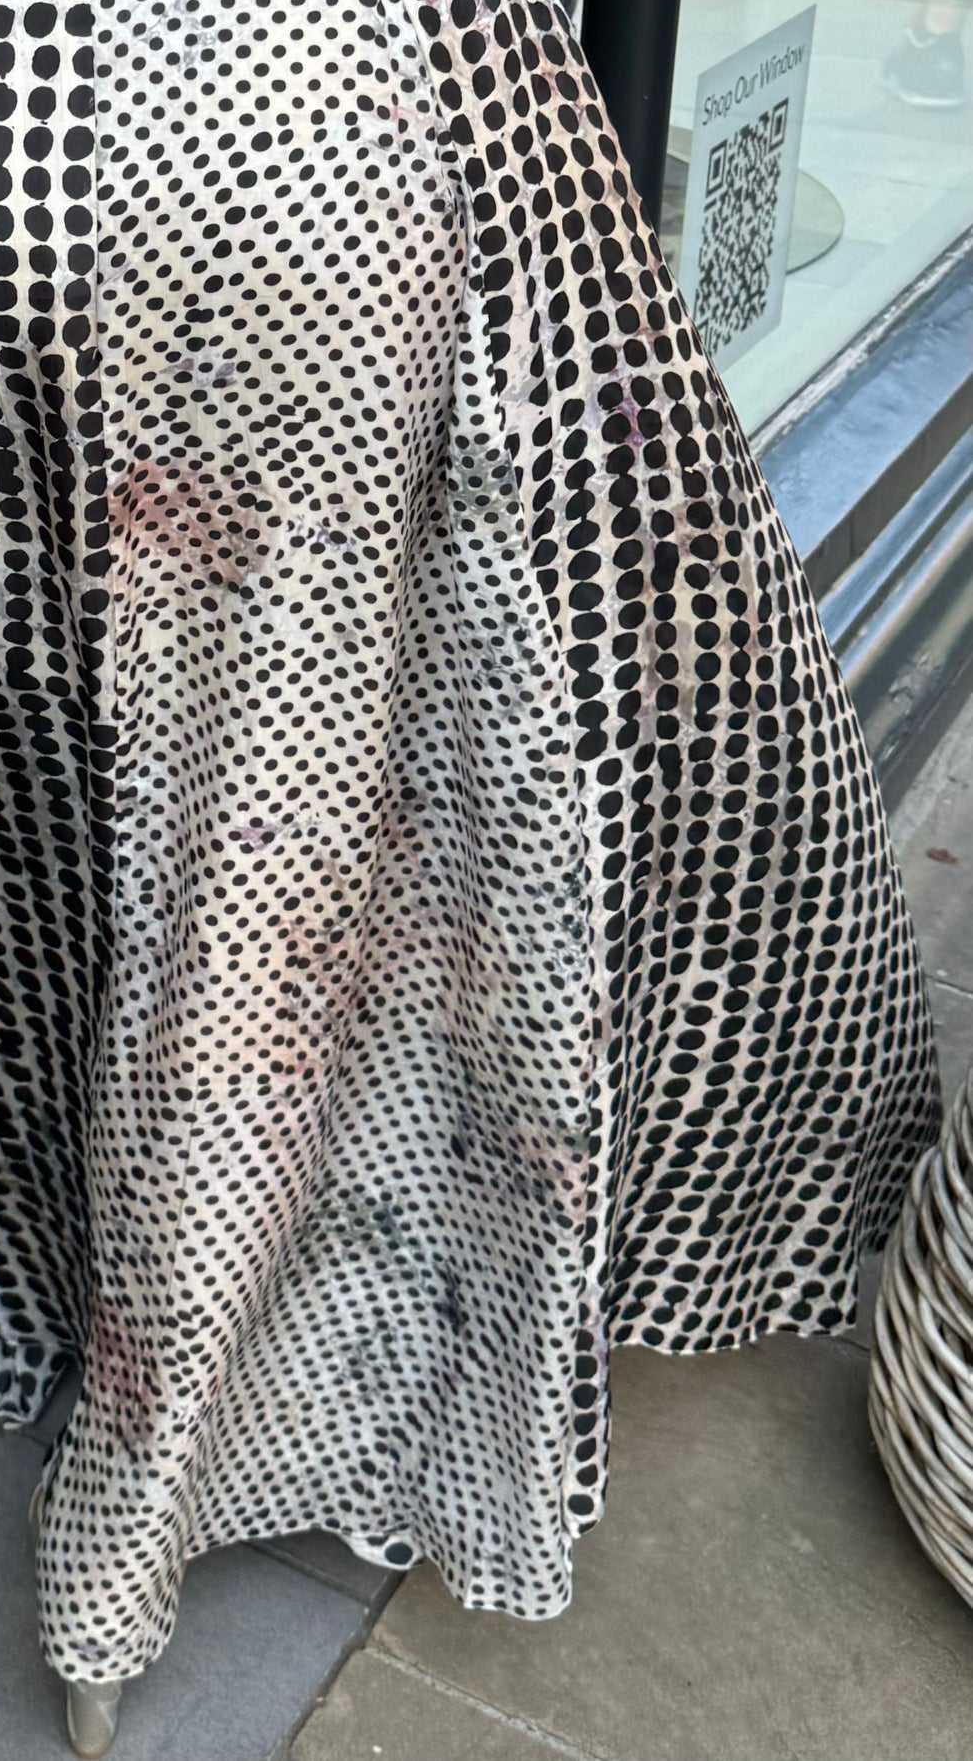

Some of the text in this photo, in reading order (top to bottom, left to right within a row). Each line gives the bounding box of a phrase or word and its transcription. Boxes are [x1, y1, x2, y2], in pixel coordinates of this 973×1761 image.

[702, 44, 806, 126] Shop Our Window
